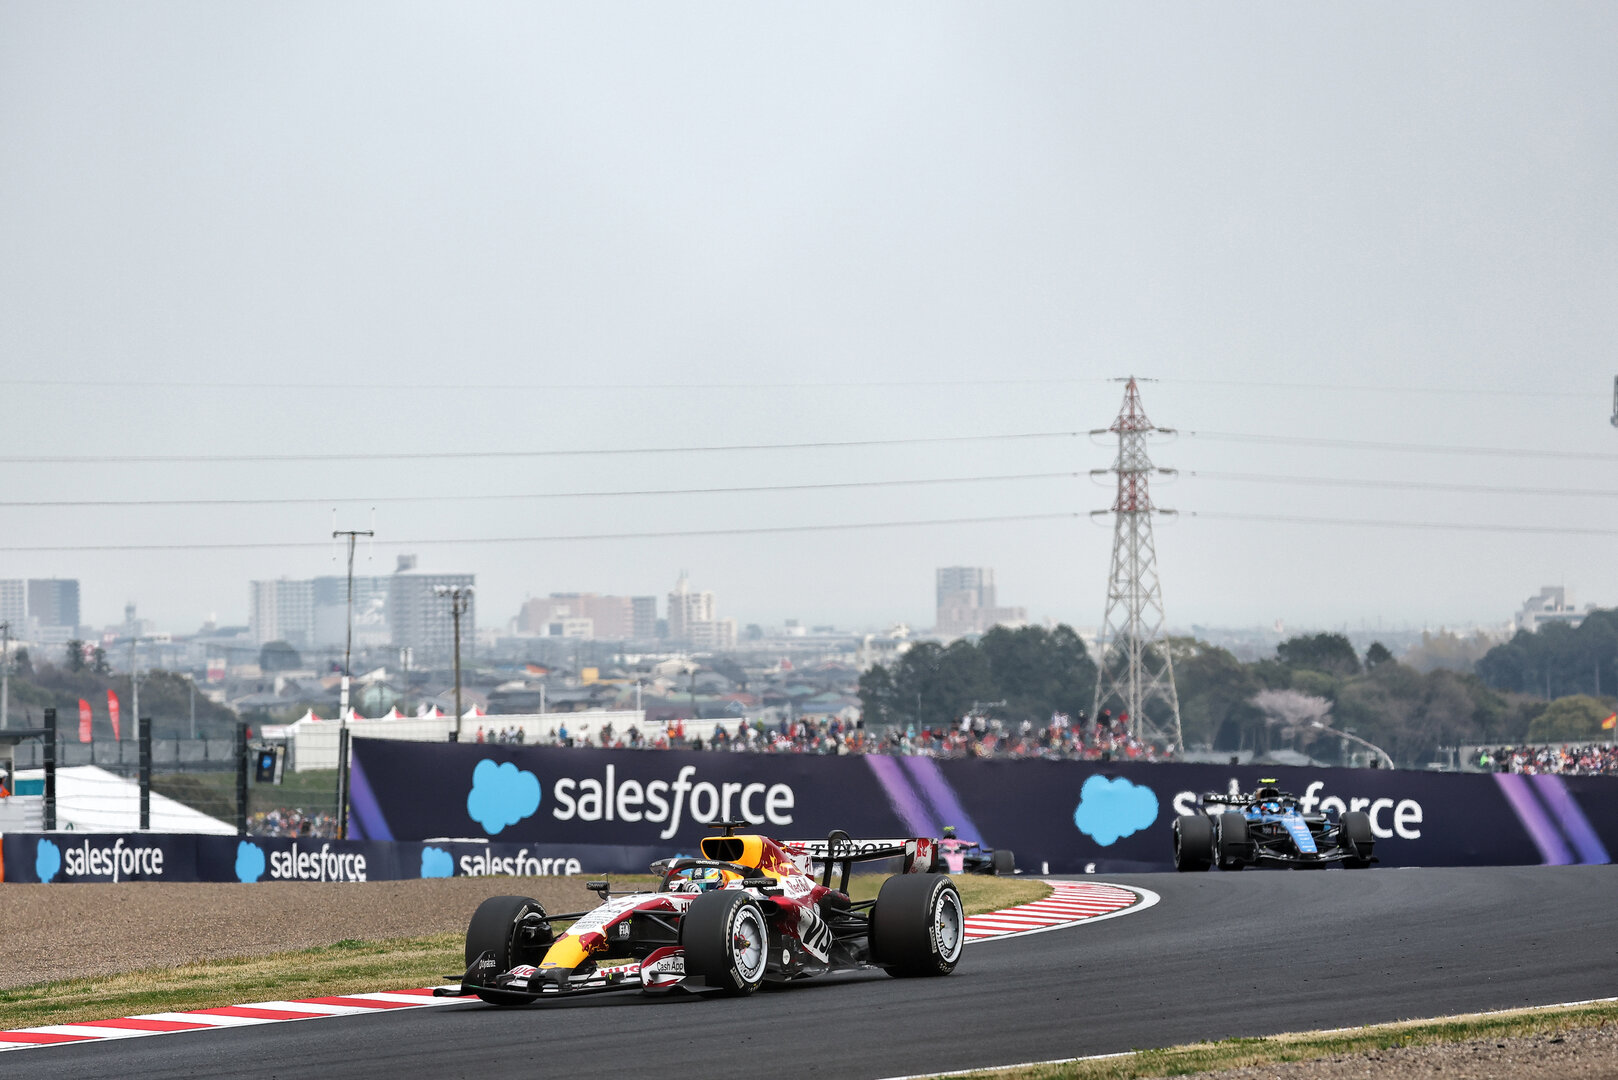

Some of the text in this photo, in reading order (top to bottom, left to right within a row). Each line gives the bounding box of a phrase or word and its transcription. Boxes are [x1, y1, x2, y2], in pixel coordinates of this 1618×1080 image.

[552, 764, 795, 840] salesforce
[65, 838, 164, 883] salesforce
[270, 842, 367, 882] salesforce
[460, 848, 582, 876] salesforce
[803, 911, 833, 956] VIS
[657, 961, 684, 972] Cash App
